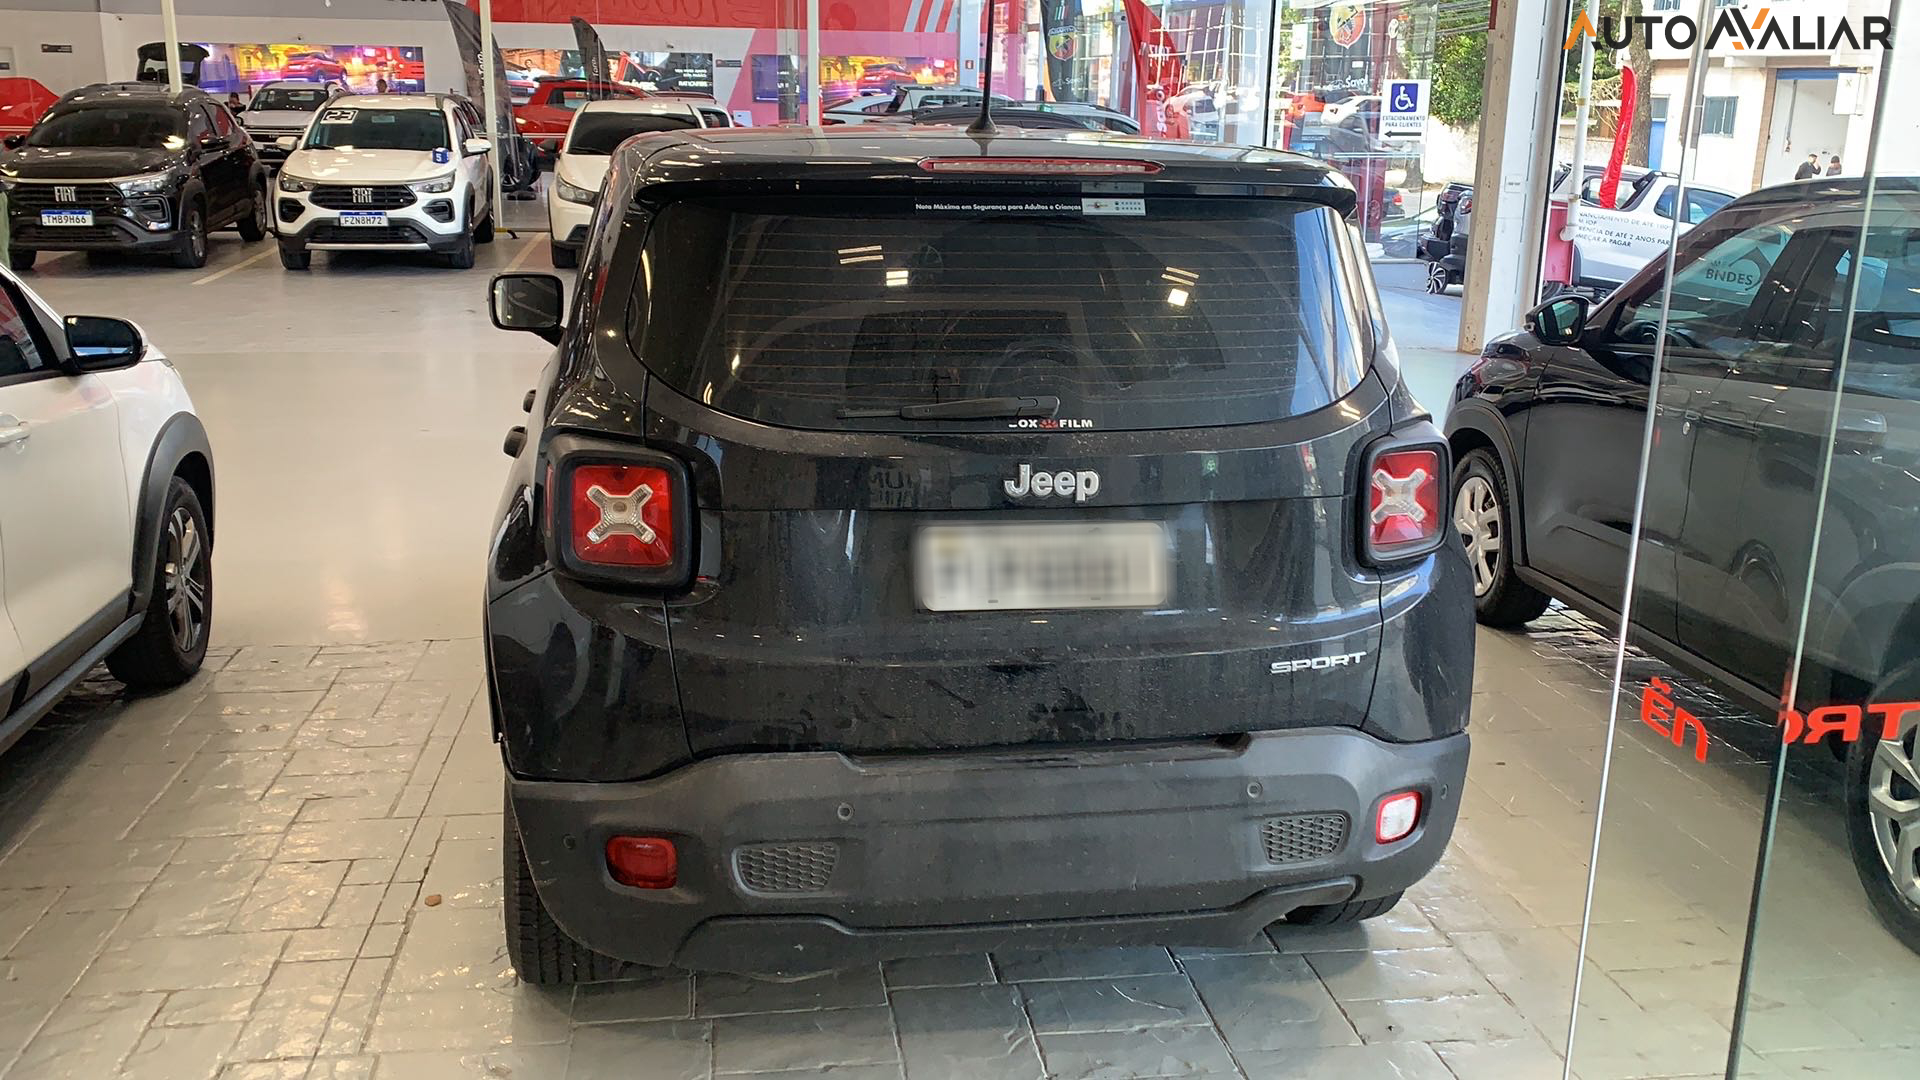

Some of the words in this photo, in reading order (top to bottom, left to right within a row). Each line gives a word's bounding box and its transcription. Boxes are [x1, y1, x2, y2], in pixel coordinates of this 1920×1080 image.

[54, 186, 76, 202] FIAT
[352, 187, 373, 203] FIAT
[973, 203, 1006, 211] Segurança
[1055, 203, 1081, 211] Crianças
[46, 215, 87, 224] TMB9H66
[1635, 235, 1655, 243] ANOS
[1059, 418, 1093, 429] FILM
[1003, 463, 1101, 504] Jeep
[1270, 651, 1368, 674] SPORT
